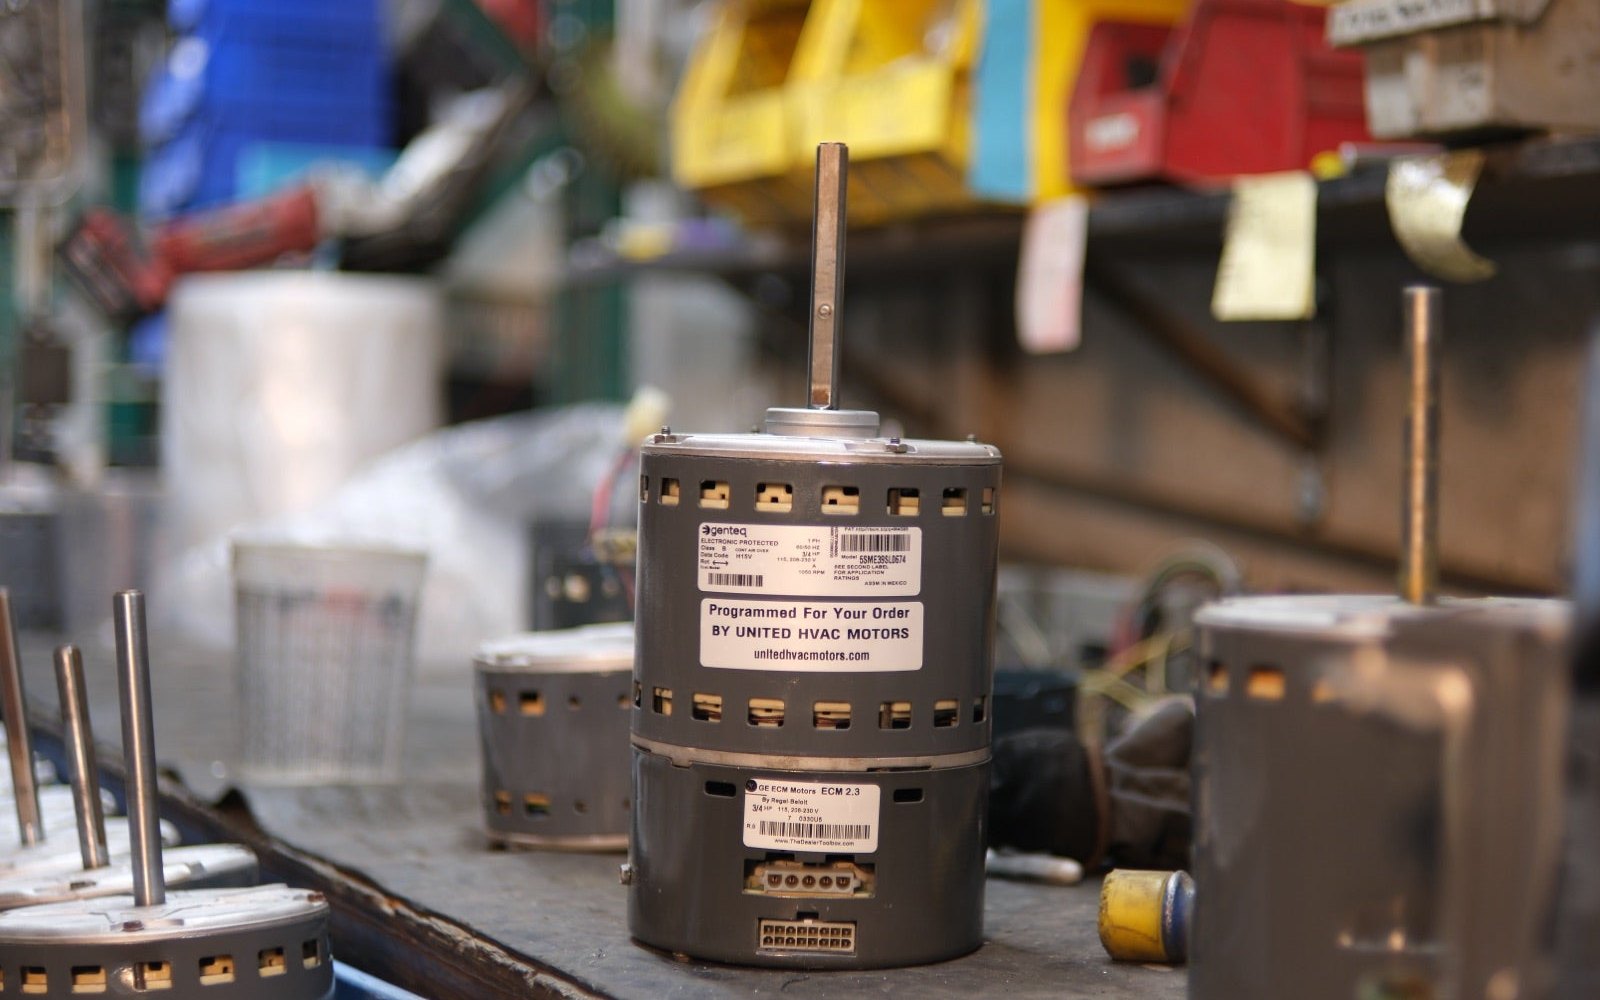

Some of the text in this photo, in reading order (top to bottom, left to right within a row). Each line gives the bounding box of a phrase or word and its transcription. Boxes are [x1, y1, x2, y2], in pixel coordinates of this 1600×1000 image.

[711, 526, 747, 537] genteq
[709, 604, 910, 619] Programmed For Your Order
[712, 625, 910, 640] BY UNITED HVAC MOTORS
[754, 649, 870, 661] unitedhvacmotors.com
[758, 784, 860, 796] GE ECM Motors ECM 2.3
[771, 797, 789, 805] Regal
[752, 804, 763, 812] 3/4
